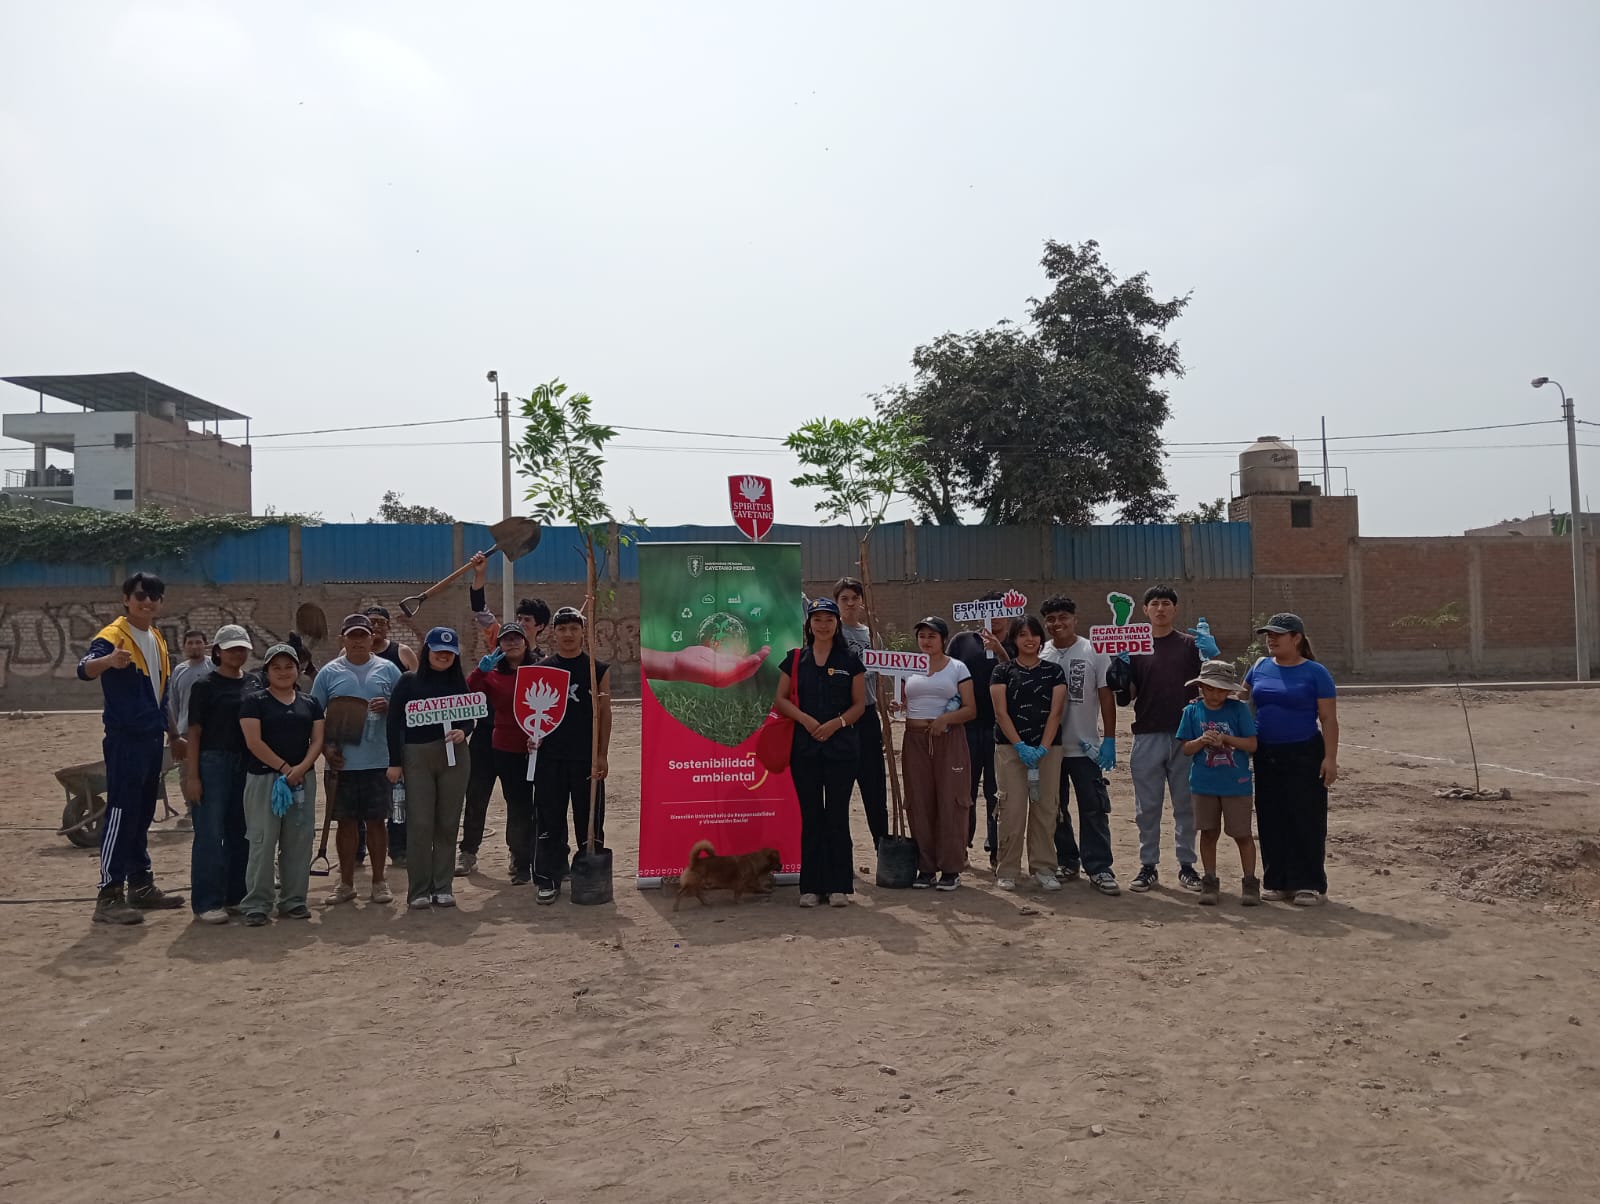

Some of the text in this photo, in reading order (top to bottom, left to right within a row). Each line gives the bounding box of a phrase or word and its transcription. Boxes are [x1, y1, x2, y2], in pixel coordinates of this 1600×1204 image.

[733, 502, 772, 511] SPIRITUS
[733, 510, 774, 519] CAYETANO
[954, 601, 1003, 613] ESPÍRITU
[954, 607, 1023, 620] CAYETANO
[1092, 626, 1150, 635] #CAYETANO
[1092, 641, 1151, 654] VERDE
[865, 651, 928, 669] DURVIS
[408, 694, 482, 713] #CAYETANO
[408, 705, 487, 725] SOSTENIBLE
[668, 758, 755, 770] Sostenibilidad
[692, 771, 755, 783] ambiental
